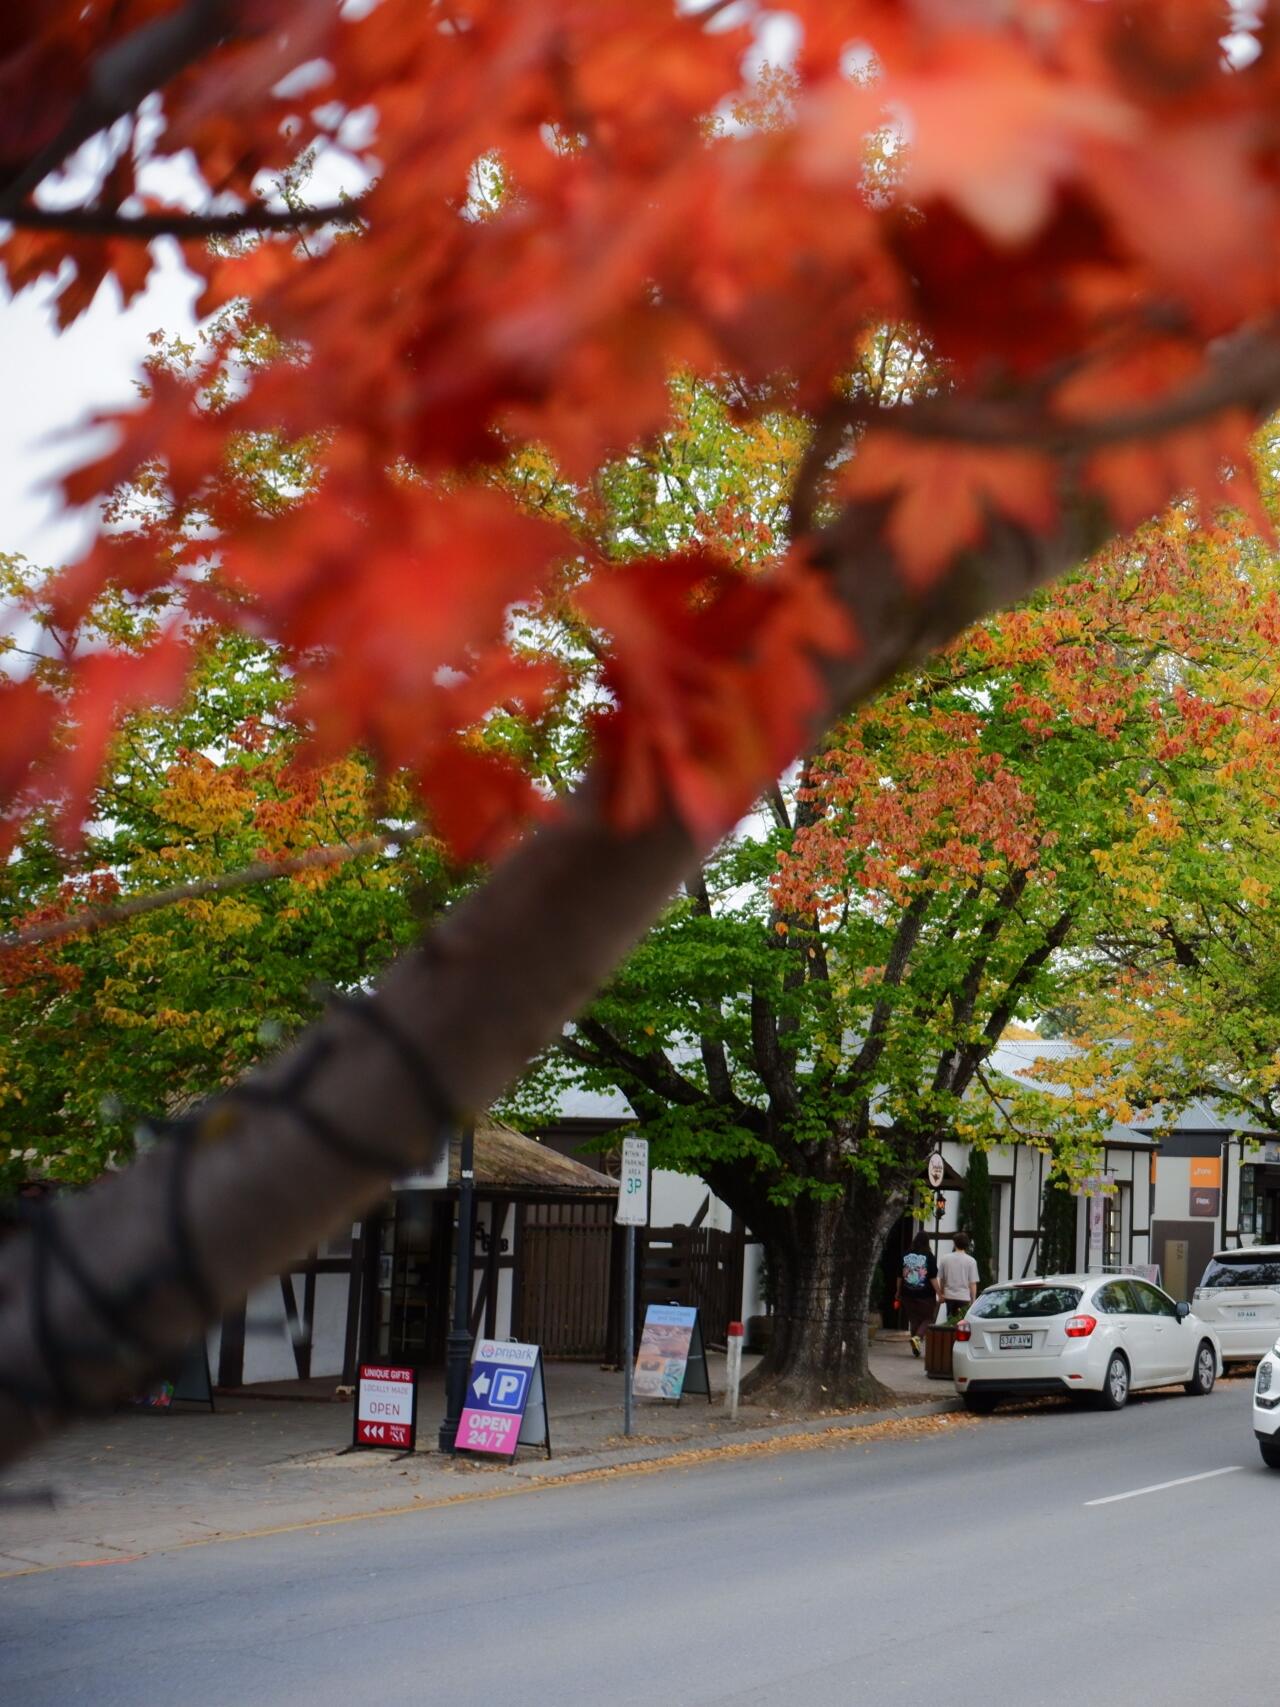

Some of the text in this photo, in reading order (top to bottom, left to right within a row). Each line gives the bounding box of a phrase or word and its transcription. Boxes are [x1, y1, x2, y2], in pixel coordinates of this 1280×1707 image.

[626, 1178, 642, 1194] 3P
[364, 1368, 410, 1380] UNIQUE GIFTS
[364, 1384, 389, 1392] LOCALLY
[496, 1375, 519, 1401] P
[369, 1401, 400, 1416] OPEN
[468, 1414, 512, 1432] OPEN
[467, 1430, 505, 1447] 24/7
